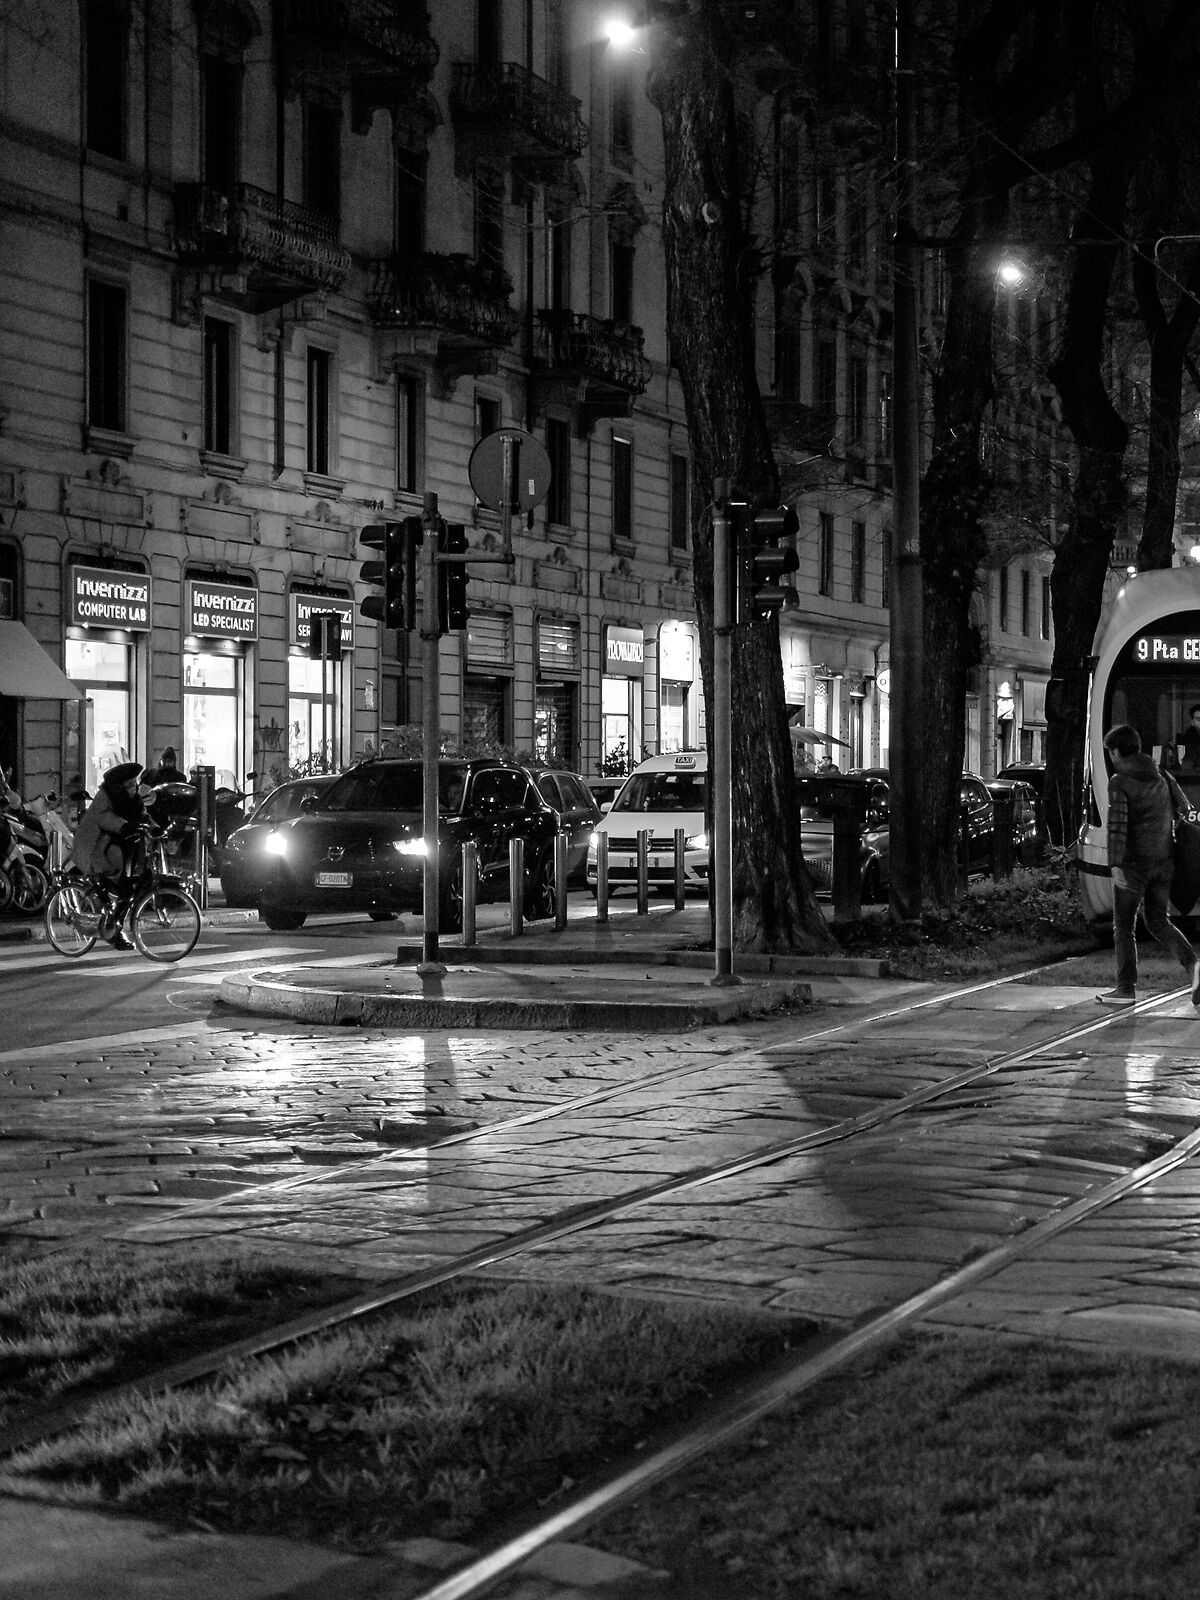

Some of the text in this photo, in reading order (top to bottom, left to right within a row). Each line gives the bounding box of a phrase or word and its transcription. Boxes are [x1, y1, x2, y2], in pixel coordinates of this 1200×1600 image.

[76, 577, 148, 602] Invernizzi
[77, 601, 147, 621] COMPUTER LAB
[193, 590, 255, 613] Invernizzi
[193, 612, 255, 632] LED SPECIALIST
[1138, 638, 1148, 660] 9
[1152, 638, 1179, 660] Pta
